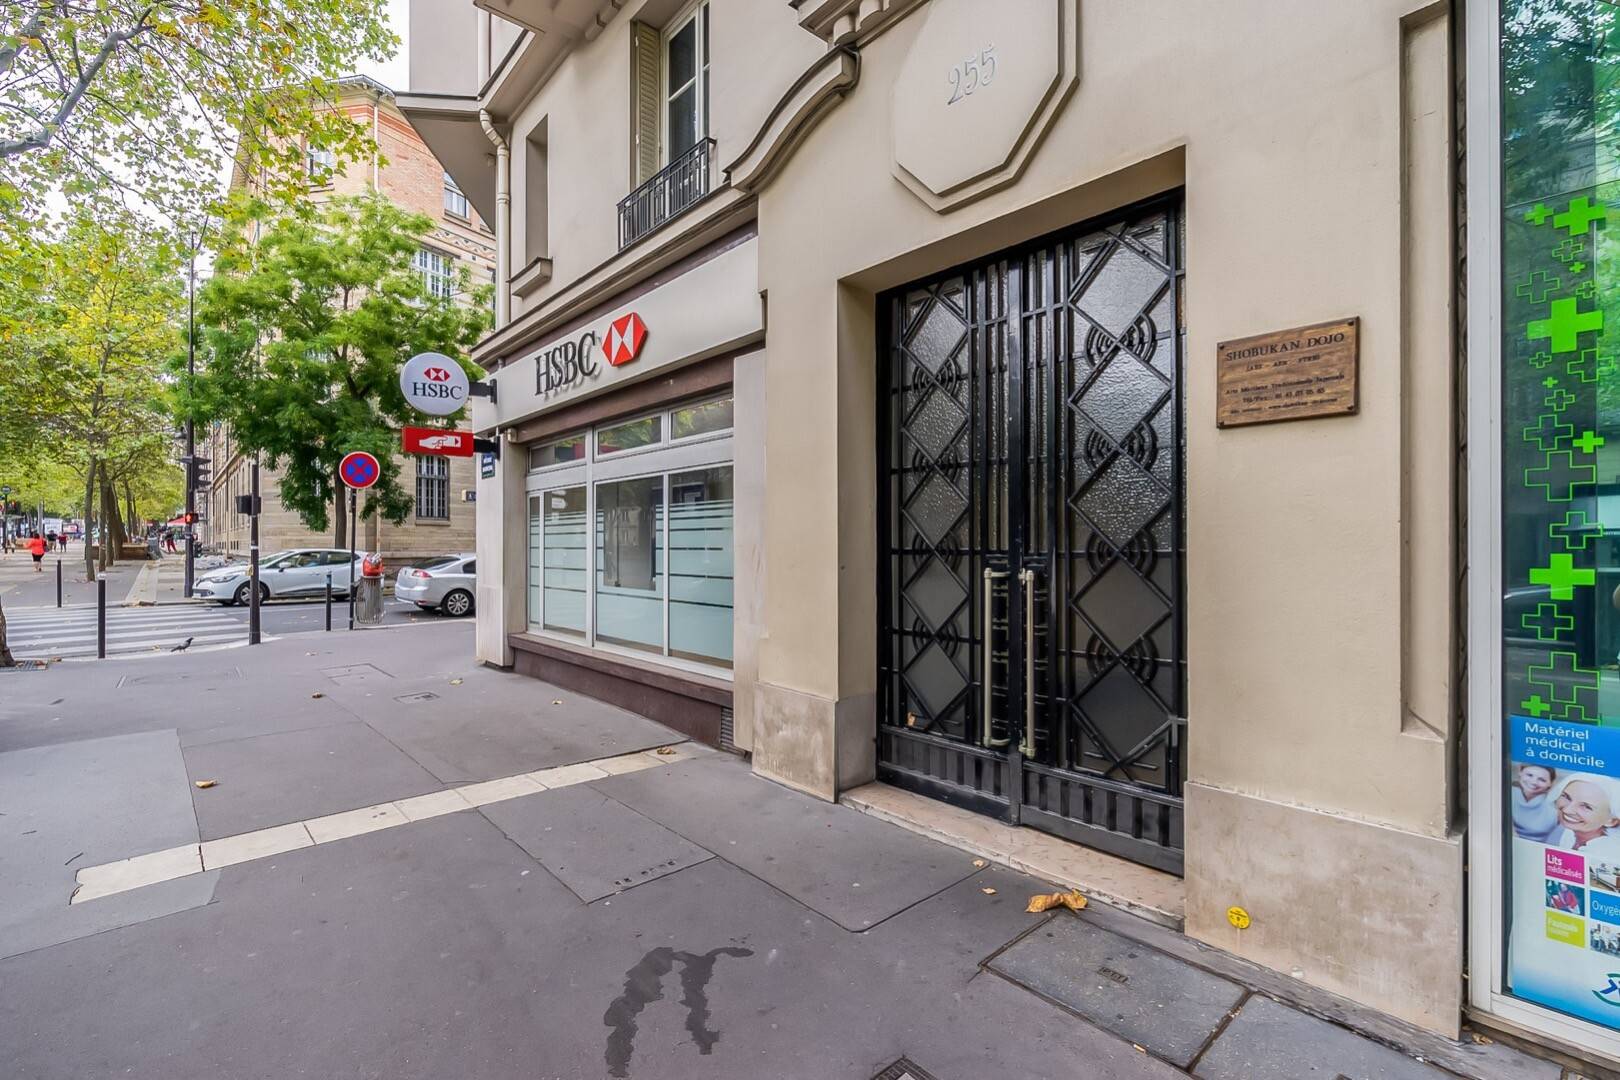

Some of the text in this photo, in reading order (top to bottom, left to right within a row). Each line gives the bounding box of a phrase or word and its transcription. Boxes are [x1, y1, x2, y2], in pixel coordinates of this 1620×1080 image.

[948, 43, 996, 105] 255
[1226, 332, 1345, 361] SHOBUKAN DOJO
[535, 331, 597, 396] HSBC
[413, 382, 462, 400] HSBC
[1525, 722, 1589, 739] Matériel
[1525, 735, 1585, 752] médical
[1525, 747, 1605, 768] à domicile
[1547, 854, 1563, 866] Lits
